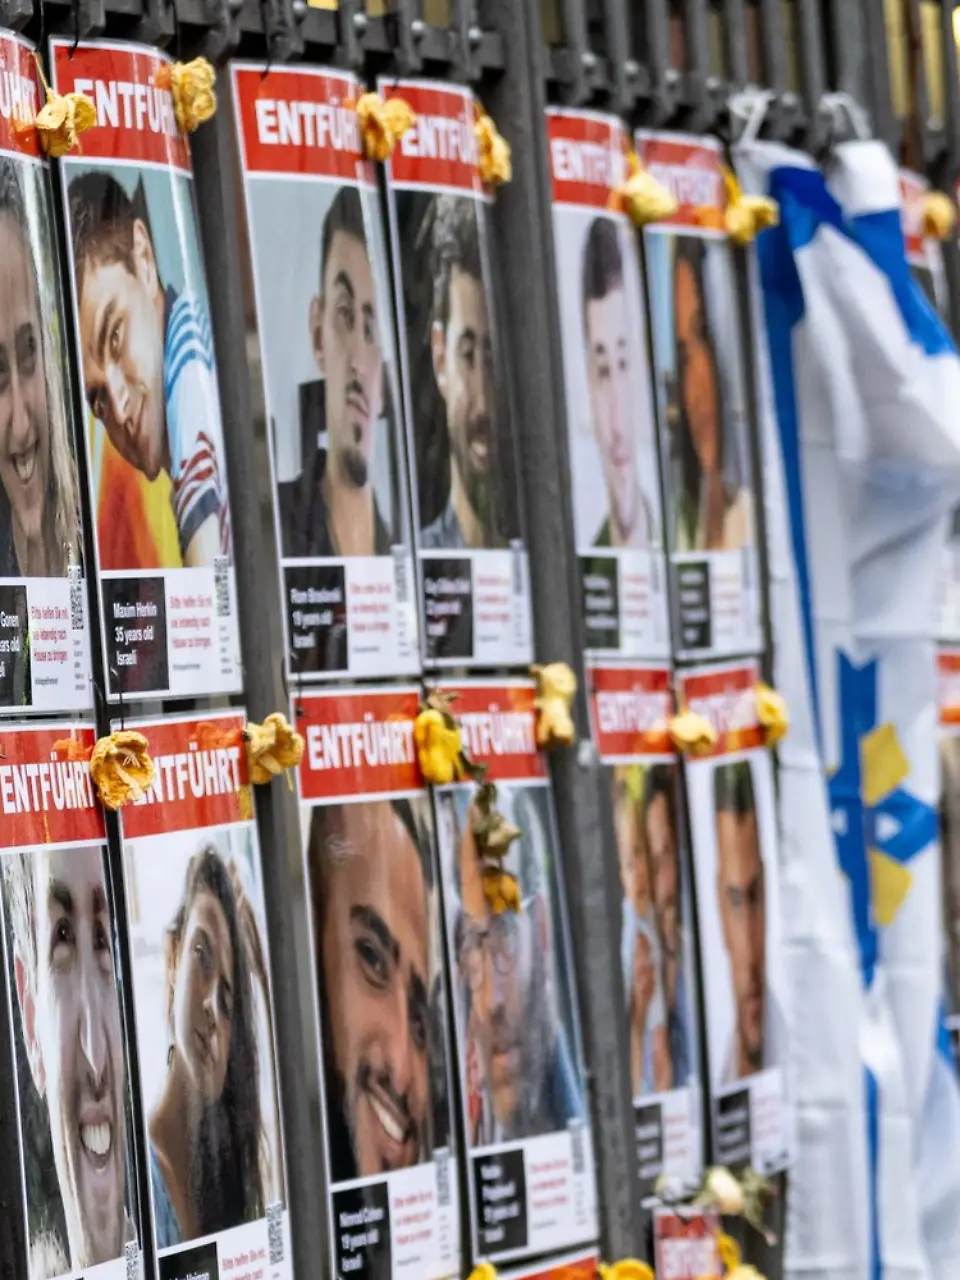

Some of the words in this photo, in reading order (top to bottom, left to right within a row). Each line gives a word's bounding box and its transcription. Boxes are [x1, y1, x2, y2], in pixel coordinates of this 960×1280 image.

[1, 612, 20, 627] Gonen
[10, 634, 22, 652] old
[306, 712, 416, 771] ENTFÜHRT
